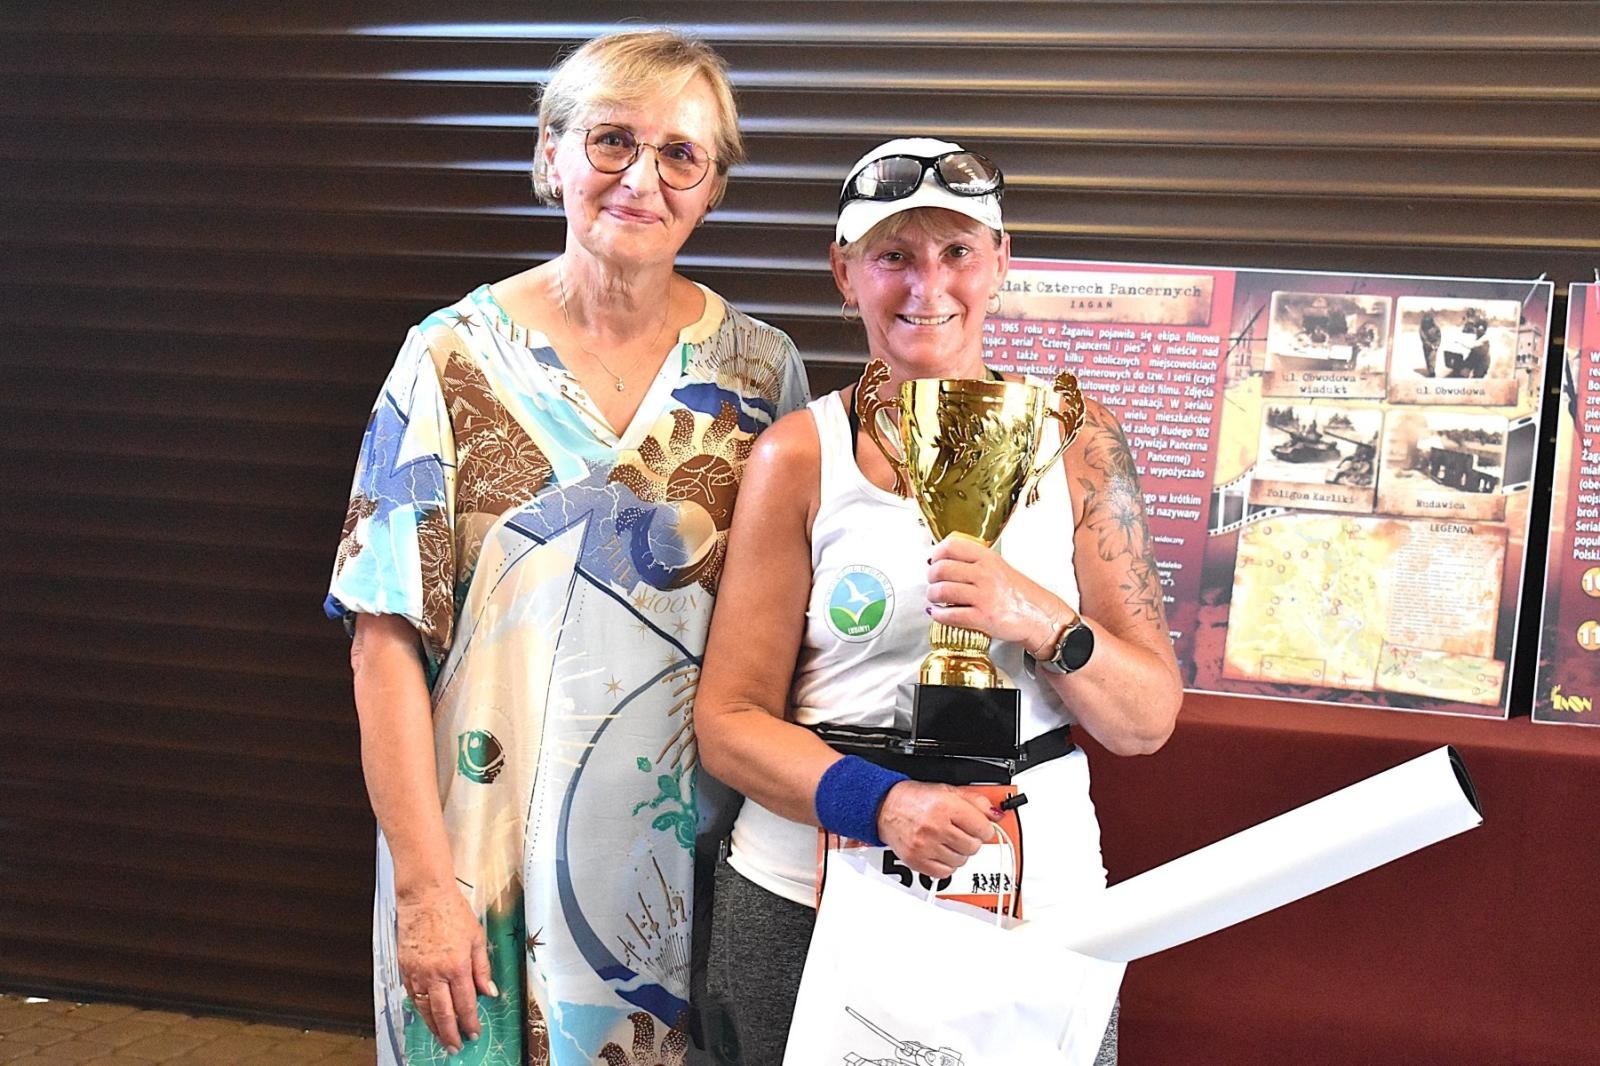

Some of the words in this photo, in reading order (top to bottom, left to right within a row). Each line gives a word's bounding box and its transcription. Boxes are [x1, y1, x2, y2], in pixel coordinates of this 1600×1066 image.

[1037, 281, 1104, 294] Czterech
[1110, 283, 1202, 299] Pancernych
[1001, 322, 1019, 333] 1965
[1024, 324, 1043, 335] roku
[1047, 327, 1056, 335] w
[1061, 324, 1094, 339] Żaganiu
[1099, 328, 1136, 341] pojawiła
[1141, 330, 1153, 343] się
[1157, 331, 1181, 343] ekipa
[1186, 332, 1220, 344] filmowa
[1011, 337, 1034, 347] serial
[1075, 341, 1111, 352] pancerni
[1115, 341, 1120, 352] i
[1152, 343, 1163, 354] W
[1166, 344, 1197, 356] mieście
[1202, 347, 1220, 357] nad
[1001, 350, 1008, 359] a
[1016, 349, 1039, 361] także
[1047, 353, 1057, 361] w
[1064, 351, 1084, 363] kilku
[1092, 354, 1140, 367] okolicznych
[1149, 357, 1217, 372] miejscowościach
[1133, 370, 1144, 379] do
[1303, 374, 1357, 383] Obwodowa
[1123, 383, 1136, 395] już
[1138, 383, 1156, 395] dziś
[1184, 386, 1215, 399] Zdjęcia
[1299, 385, 1348, 395] wiadukt
[1434, 387, 1486, 397] Obwodowa
[1170, 399, 1179, 409] W
[1184, 400, 1213, 411] serialu
[1585, 395, 1600, 405] zre
[1124, 409, 1148, 421] wielu
[1156, 411, 1211, 425] mieszkańców
[1134, 424, 1159, 437] załogi
[1161, 426, 1193, 439] Rudego
[1195, 428, 1210, 438] 102
[1584, 422, 1600, 433] trw
[1134, 438, 1168, 450] Dywizja
[1169, 440, 1208, 452] Pancerna
[1582, 438, 1593, 447] w
[1147, 451, 1191, 466] Pancernej)
[1150, 467, 1205, 480] wypożyczało
[1579, 478, 1600, 491] (obe
[1158, 494, 1168, 503] w
[1169, 493, 1202, 506] krótkim
[1578, 492, 1600, 506] wojs
[1156, 508, 1201, 521] nazywany
[1576, 506, 1600, 518] broń
[1429, 523, 1475, 535] LEGENDA
